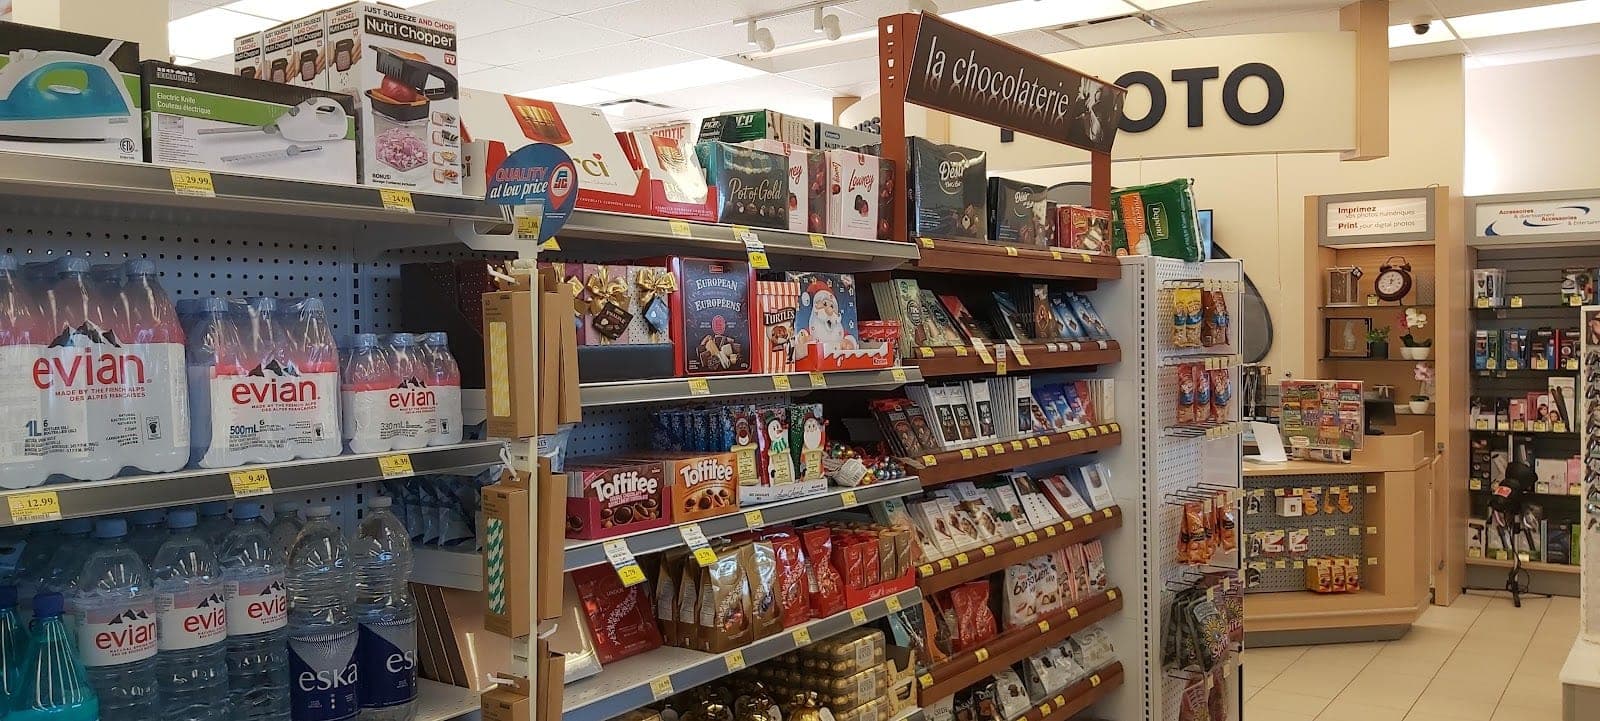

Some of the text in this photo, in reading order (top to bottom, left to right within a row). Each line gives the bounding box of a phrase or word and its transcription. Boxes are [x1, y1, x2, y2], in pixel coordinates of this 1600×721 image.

[365, 5, 382, 15] JUST
[383, 9, 417, 23] SQUEEZE
[418, 18, 433, 27] AND
[366, 17, 453, 47] Nutri Chopper
[925, 35, 1070, 117] la chocolaterie
[156, 92, 180, 102] Electric
[157, 101, 182, 110] Couteau
[495, 166, 550, 182] QUALITY
[848, 168, 875, 193] Lowney
[502, 182, 521, 197] low
[520, 178, 549, 200] price
[728, 177, 782, 202] Pot of Gold
[1338, 206, 1377, 214] Imprimez
[1152, 206, 1166, 237] Depend
[1338, 222, 1359, 230] Print
[1393, 220, 1416, 228] photos
[695, 277, 738, 291] EUROPEAN
[765, 310, 796, 325] TURTLES
[32, 346, 146, 391] evian
[69, 394, 86, 402] DES
[231, 378, 318, 405] evian
[389, 388, 436, 408] evian
[25, 419, 43, 437] 1L
[229, 424, 259, 435] 500mL
[679, 458, 733, 489] Toffifee
[590, 470, 658, 503] Toffifee
[298, 661, 359, 692] eska
